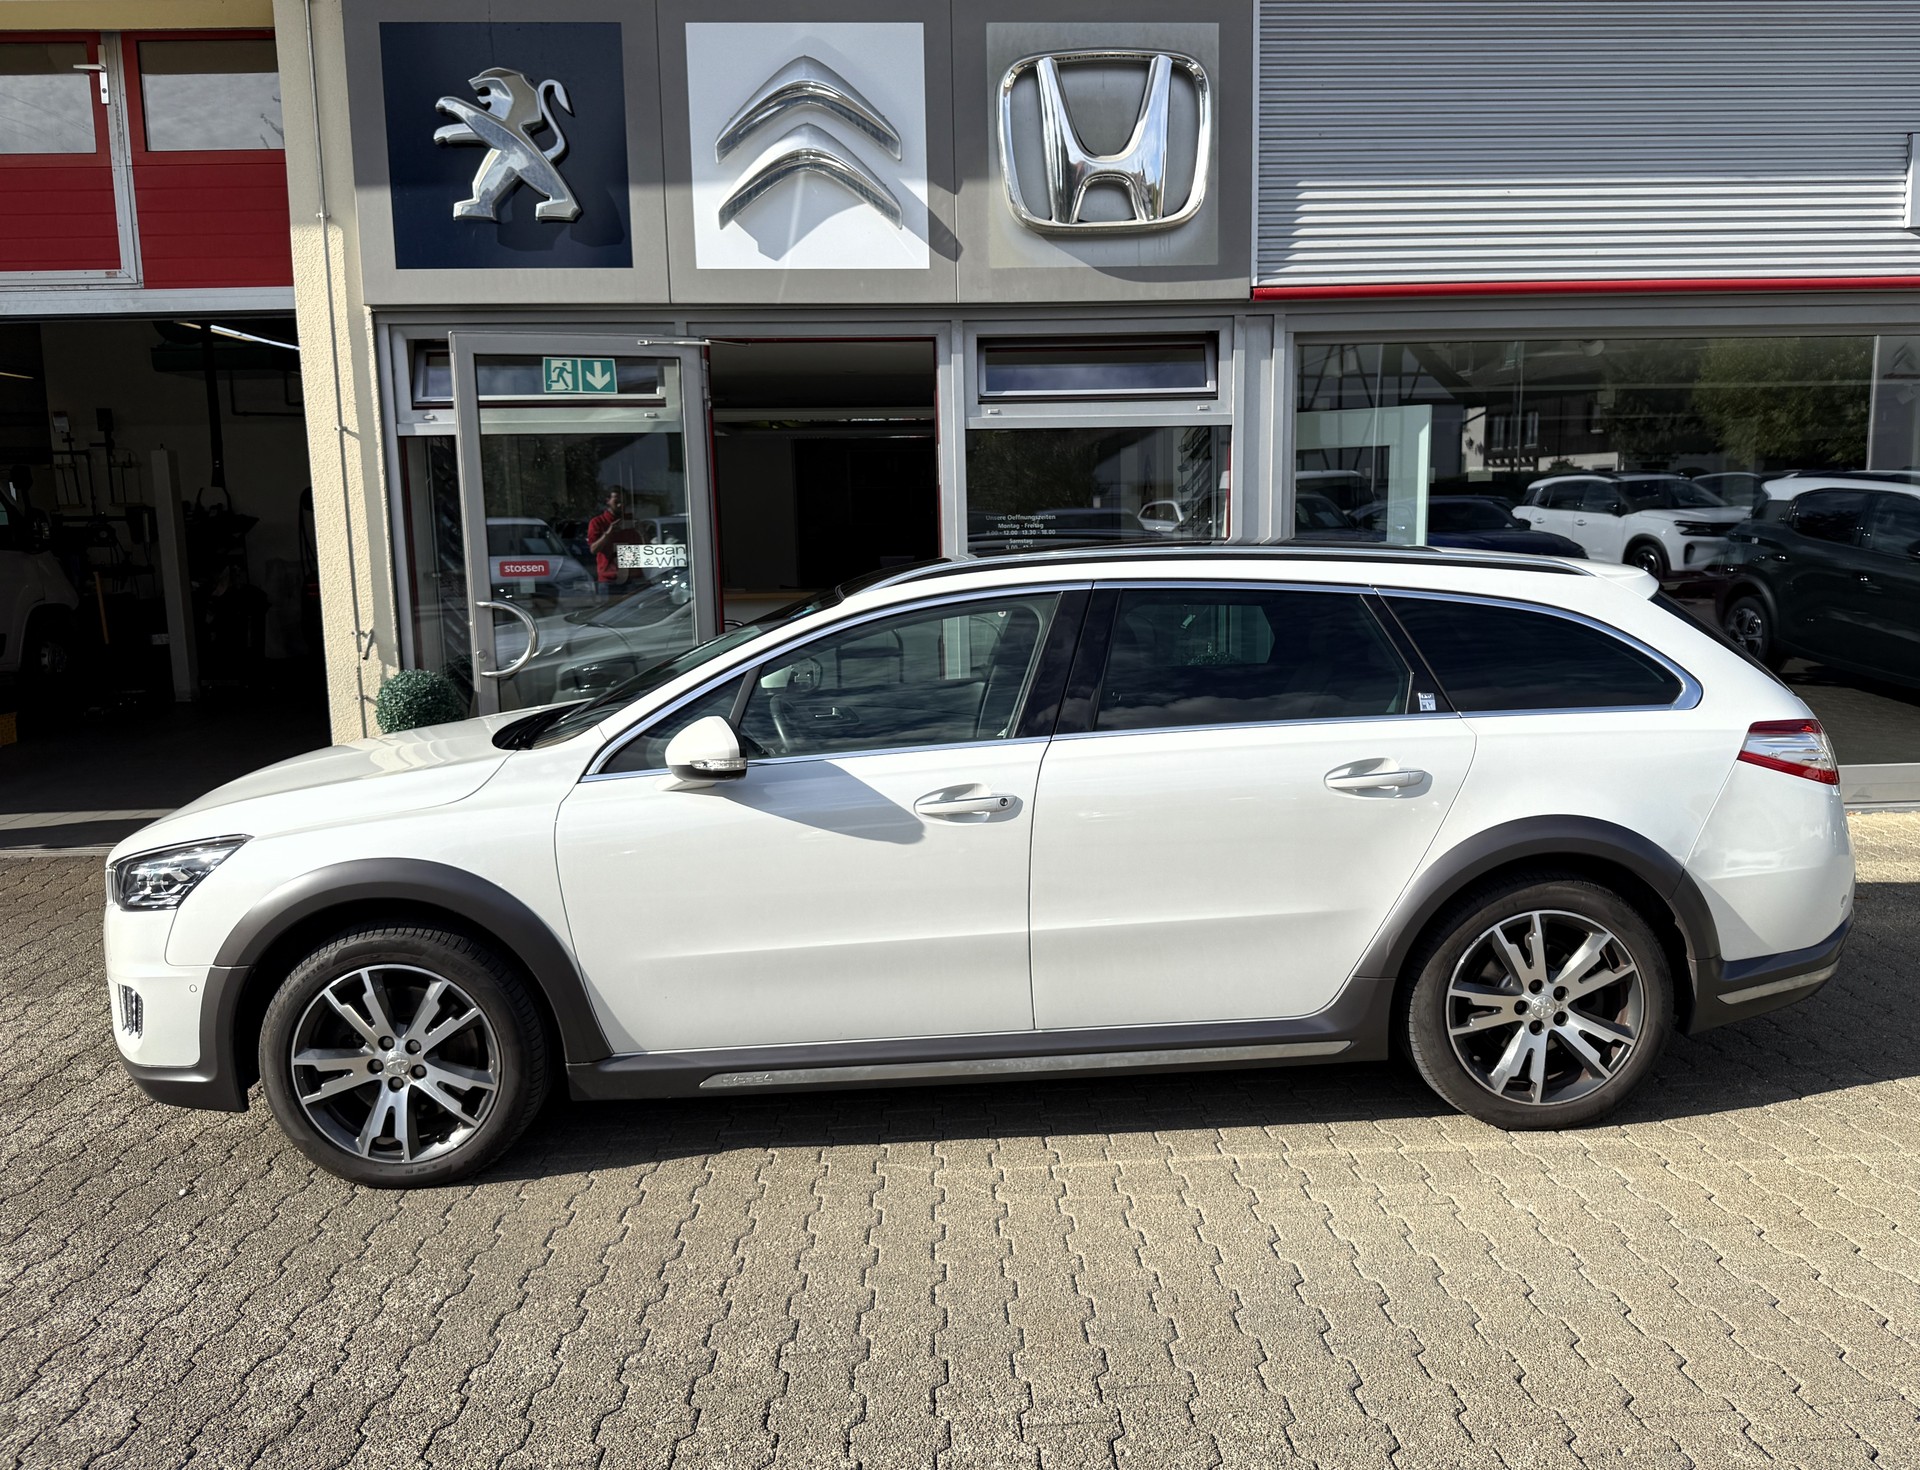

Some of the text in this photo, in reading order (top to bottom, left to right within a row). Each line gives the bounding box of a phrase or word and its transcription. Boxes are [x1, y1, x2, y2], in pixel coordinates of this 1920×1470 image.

[643, 545, 686, 555] Scan
[644, 555, 687, 566] & Win
[504, 564, 545, 573] stossen
